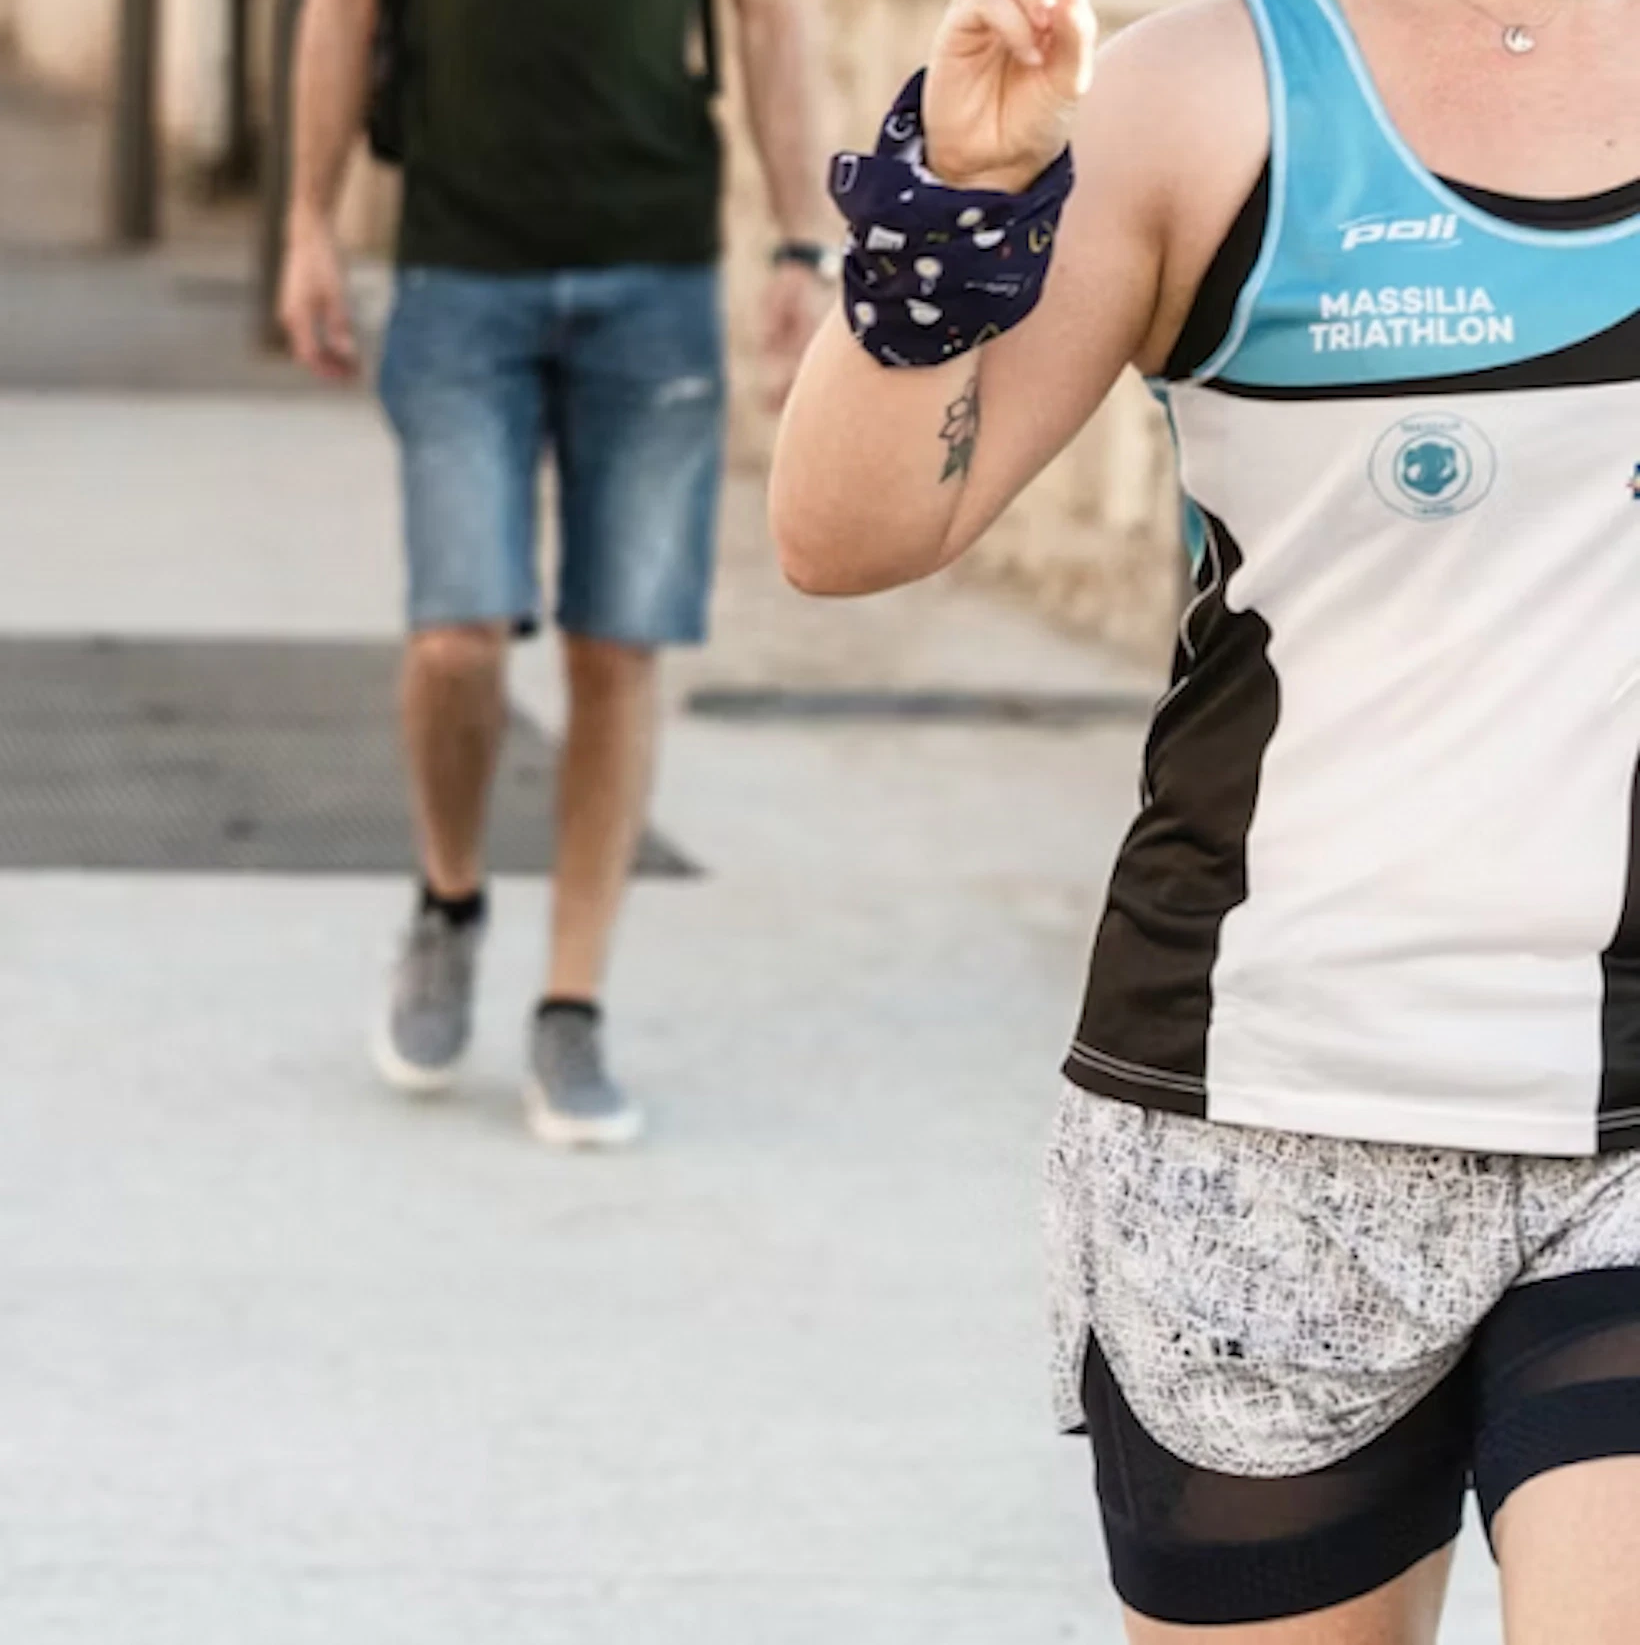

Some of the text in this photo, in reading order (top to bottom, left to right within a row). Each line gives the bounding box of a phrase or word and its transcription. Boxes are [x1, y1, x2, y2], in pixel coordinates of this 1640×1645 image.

[1340, 214, 1458, 251] poli
[1320, 287, 1495, 320] MASSILIA
[1308, 316, 1515, 353] TRIATHLON
